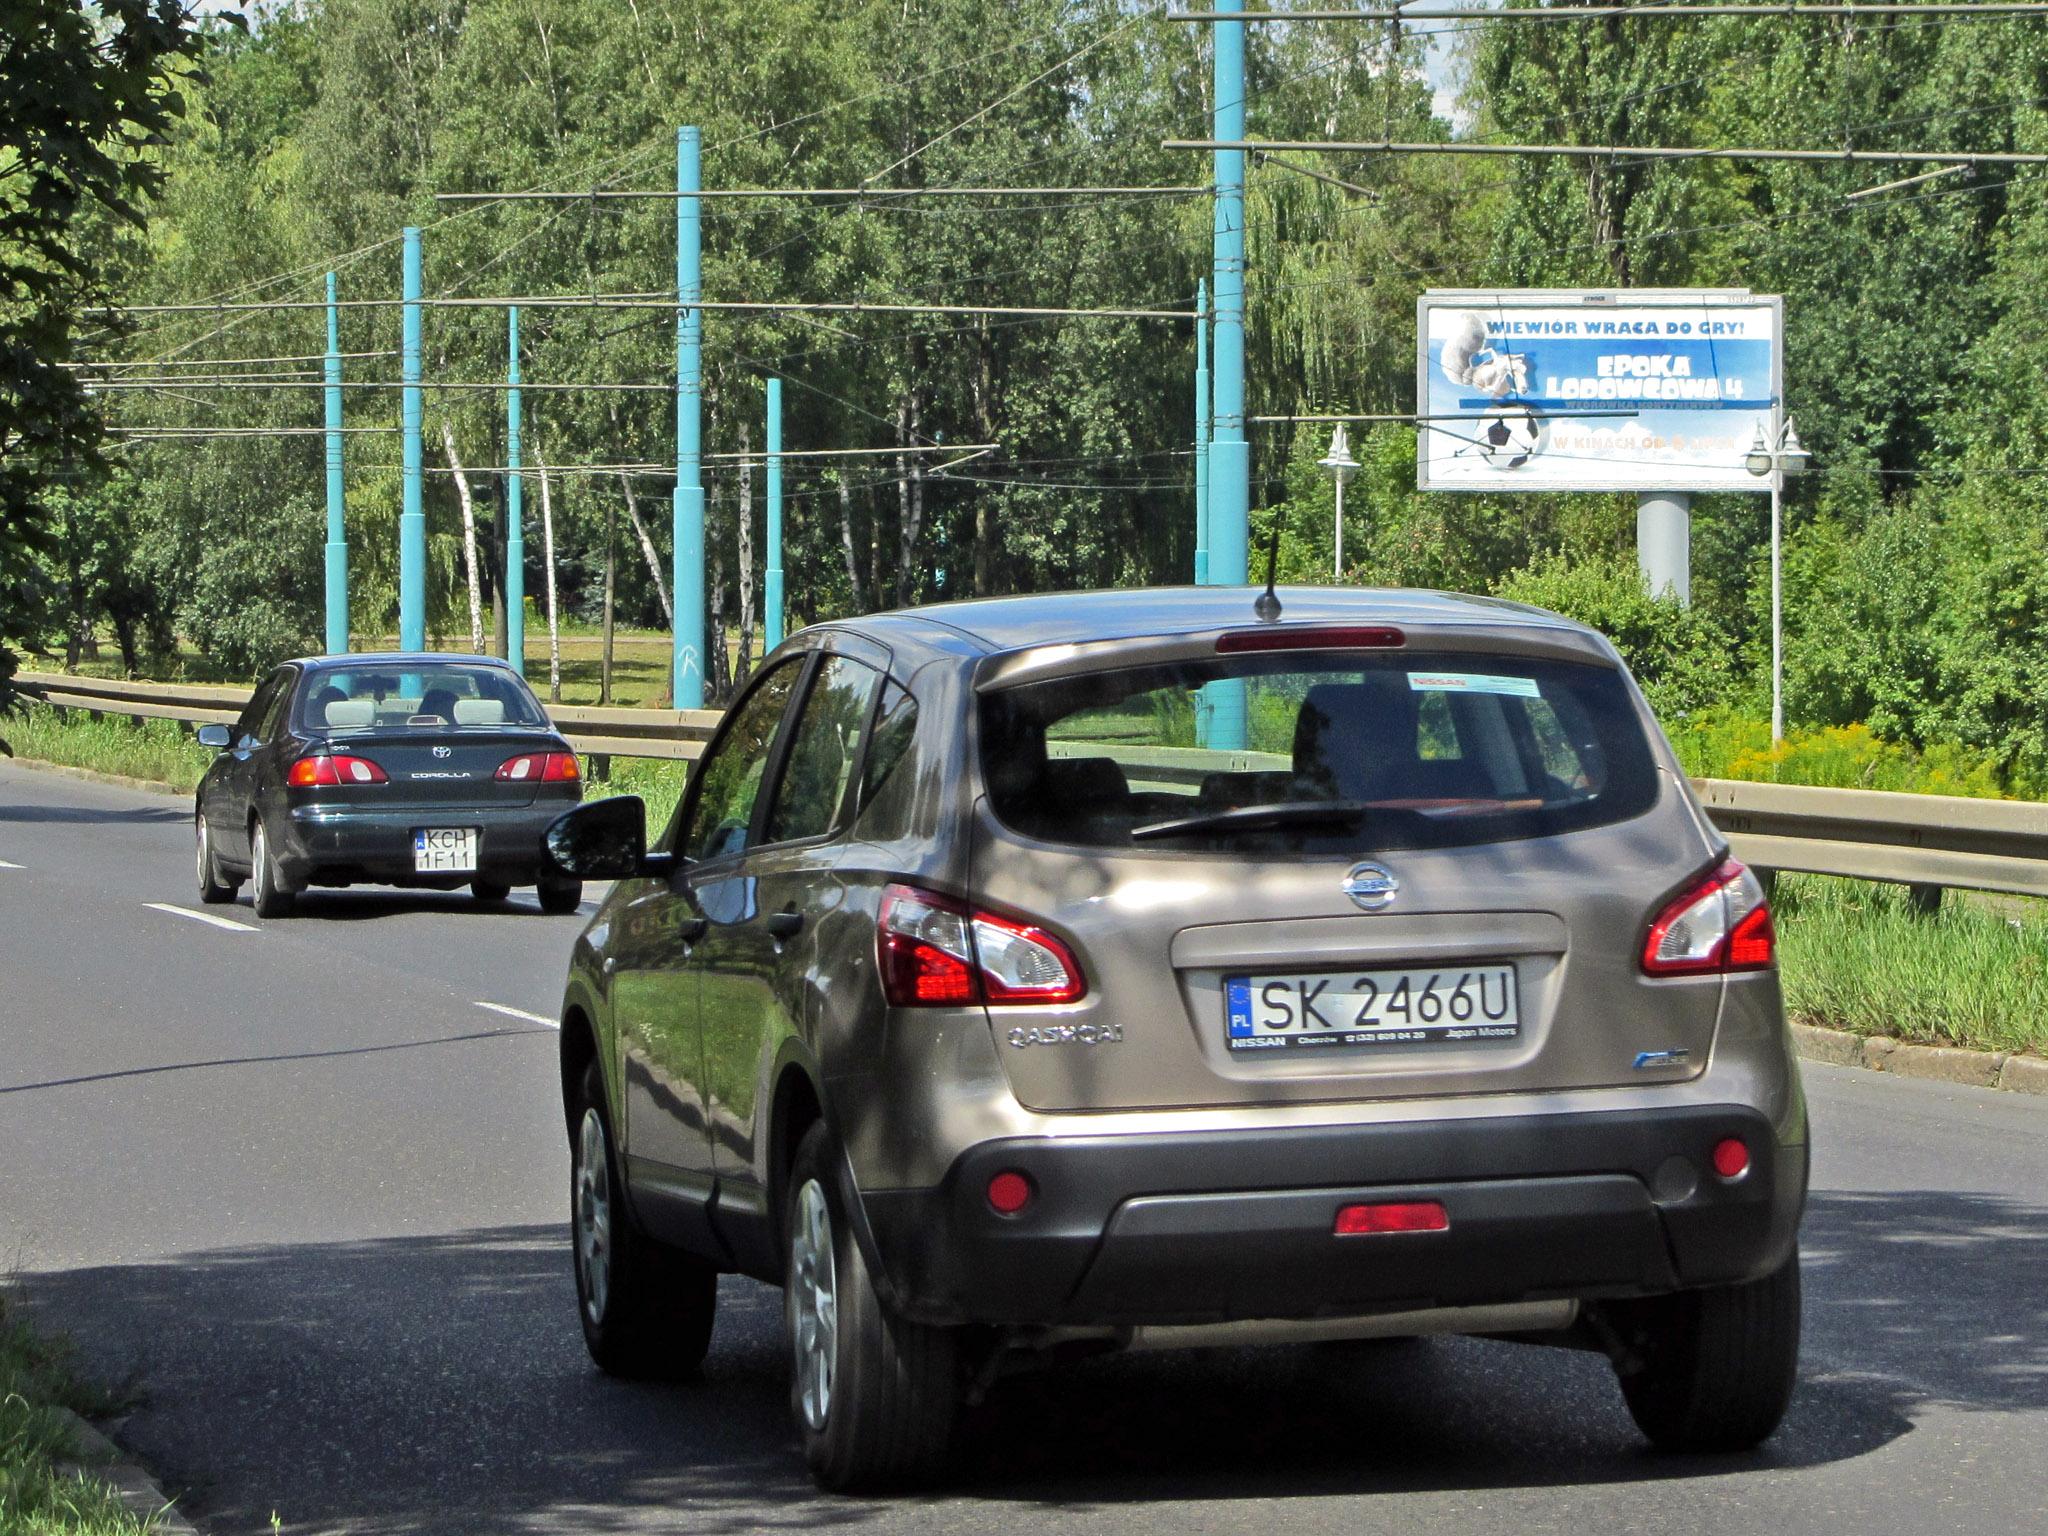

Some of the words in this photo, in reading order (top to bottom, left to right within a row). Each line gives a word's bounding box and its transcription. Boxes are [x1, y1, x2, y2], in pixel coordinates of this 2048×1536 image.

[1487, 319, 1578, 335] WIEWIÓR
[1583, 321, 1660, 335] WRACA
[1665, 321, 1693, 335] DO
[1697, 321, 1745, 335] GRY!
[1596, 354, 1693, 377] EPOKA
[1545, 376, 1720, 400] LODOWCOWA
[1725, 377, 1744, 399] 4
[426, 830, 467, 849] KCH
[424, 851, 468, 869] 1F11
[1261, 981, 1333, 1029] SK
[1353, 973, 1507, 1026] 2466U
[1232, 1014, 1250, 1027] PL
[1007, 1024, 1123, 1048] QASHQAI
[1231, 1037, 1286, 1048] NISSAN
[1479, 1027, 1517, 1036] Motors
